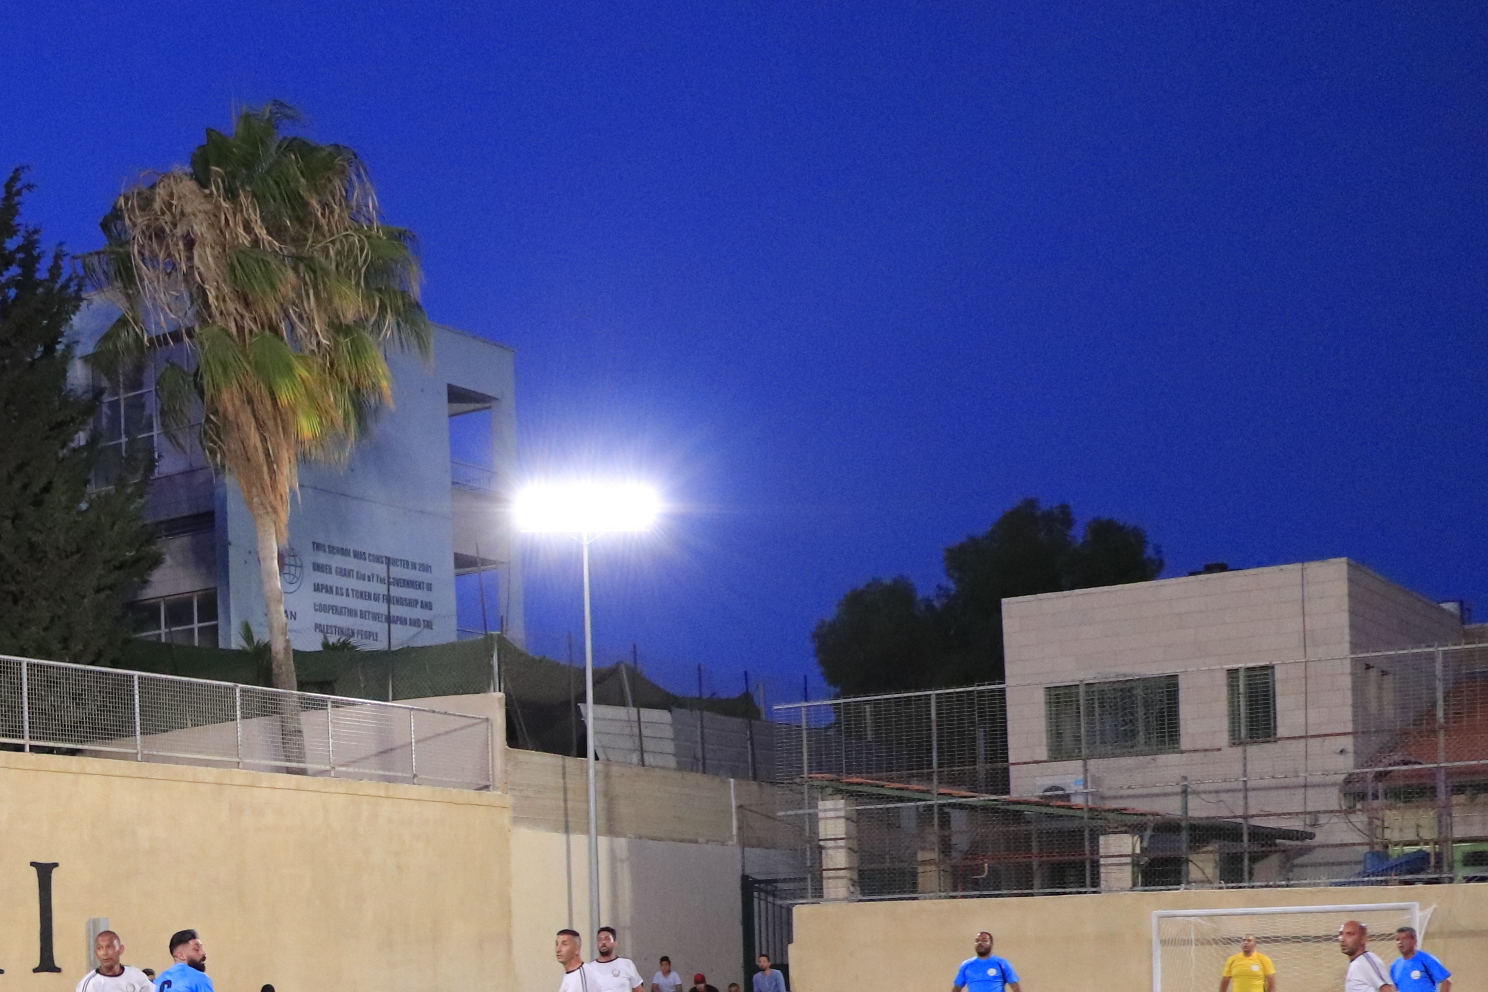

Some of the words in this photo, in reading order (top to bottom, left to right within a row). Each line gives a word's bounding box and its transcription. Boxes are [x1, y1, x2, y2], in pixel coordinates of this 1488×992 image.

[312, 541, 327, 554] THIS
[327, 544, 351, 558] SCHOOL
[352, 549, 367, 562] WAS
[312, 561, 333, 575] UNDER
[335, 566, 355, 579] GRANT
[388, 576, 425, 591] GOVERNMENT
[313, 582, 334, 595] JAPAN
[335, 585, 344, 597] AS
[345, 587, 350, 598] A
[350, 588, 372, 601] TOKEN
[373, 592, 381, 603] OF
[420, 599, 433, 611] AND
[313, 602, 358, 618] COOPERATION
[408, 617, 422, 629] AND
[314, 622, 355, 639] PALESTINIAN
